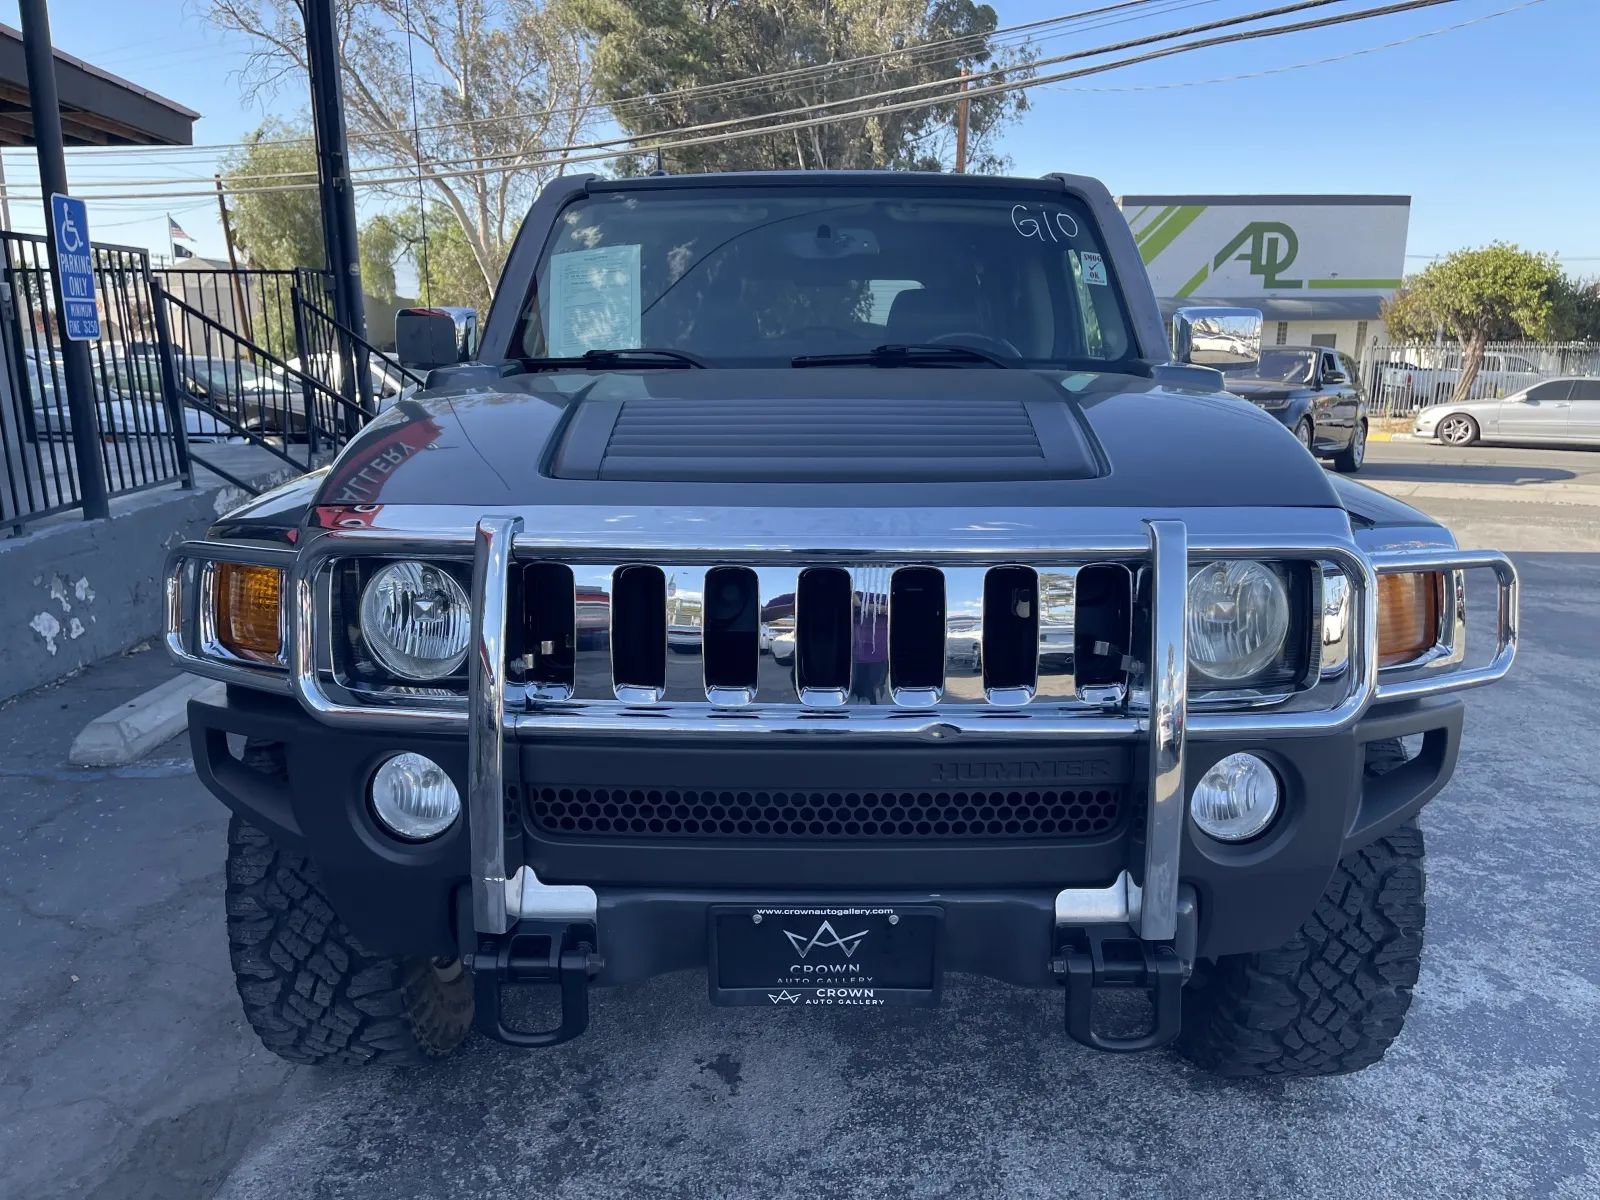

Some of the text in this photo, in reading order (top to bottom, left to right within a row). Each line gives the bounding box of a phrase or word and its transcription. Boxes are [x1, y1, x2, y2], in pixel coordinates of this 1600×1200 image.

[61, 253, 91, 274] PARKING
[1089, 271, 1100, 279] OK
[69, 277, 88, 296] ONLY
[71, 304, 92, 317] MINIMUM
[69, 320, 98, 334] FINE $250
[929, 758, 1113, 783] HUMMER
[756, 907, 894, 916] www.crownautogallery.com
[789, 963, 860, 975] CROWN
[816, 988, 874, 998] CROWN
